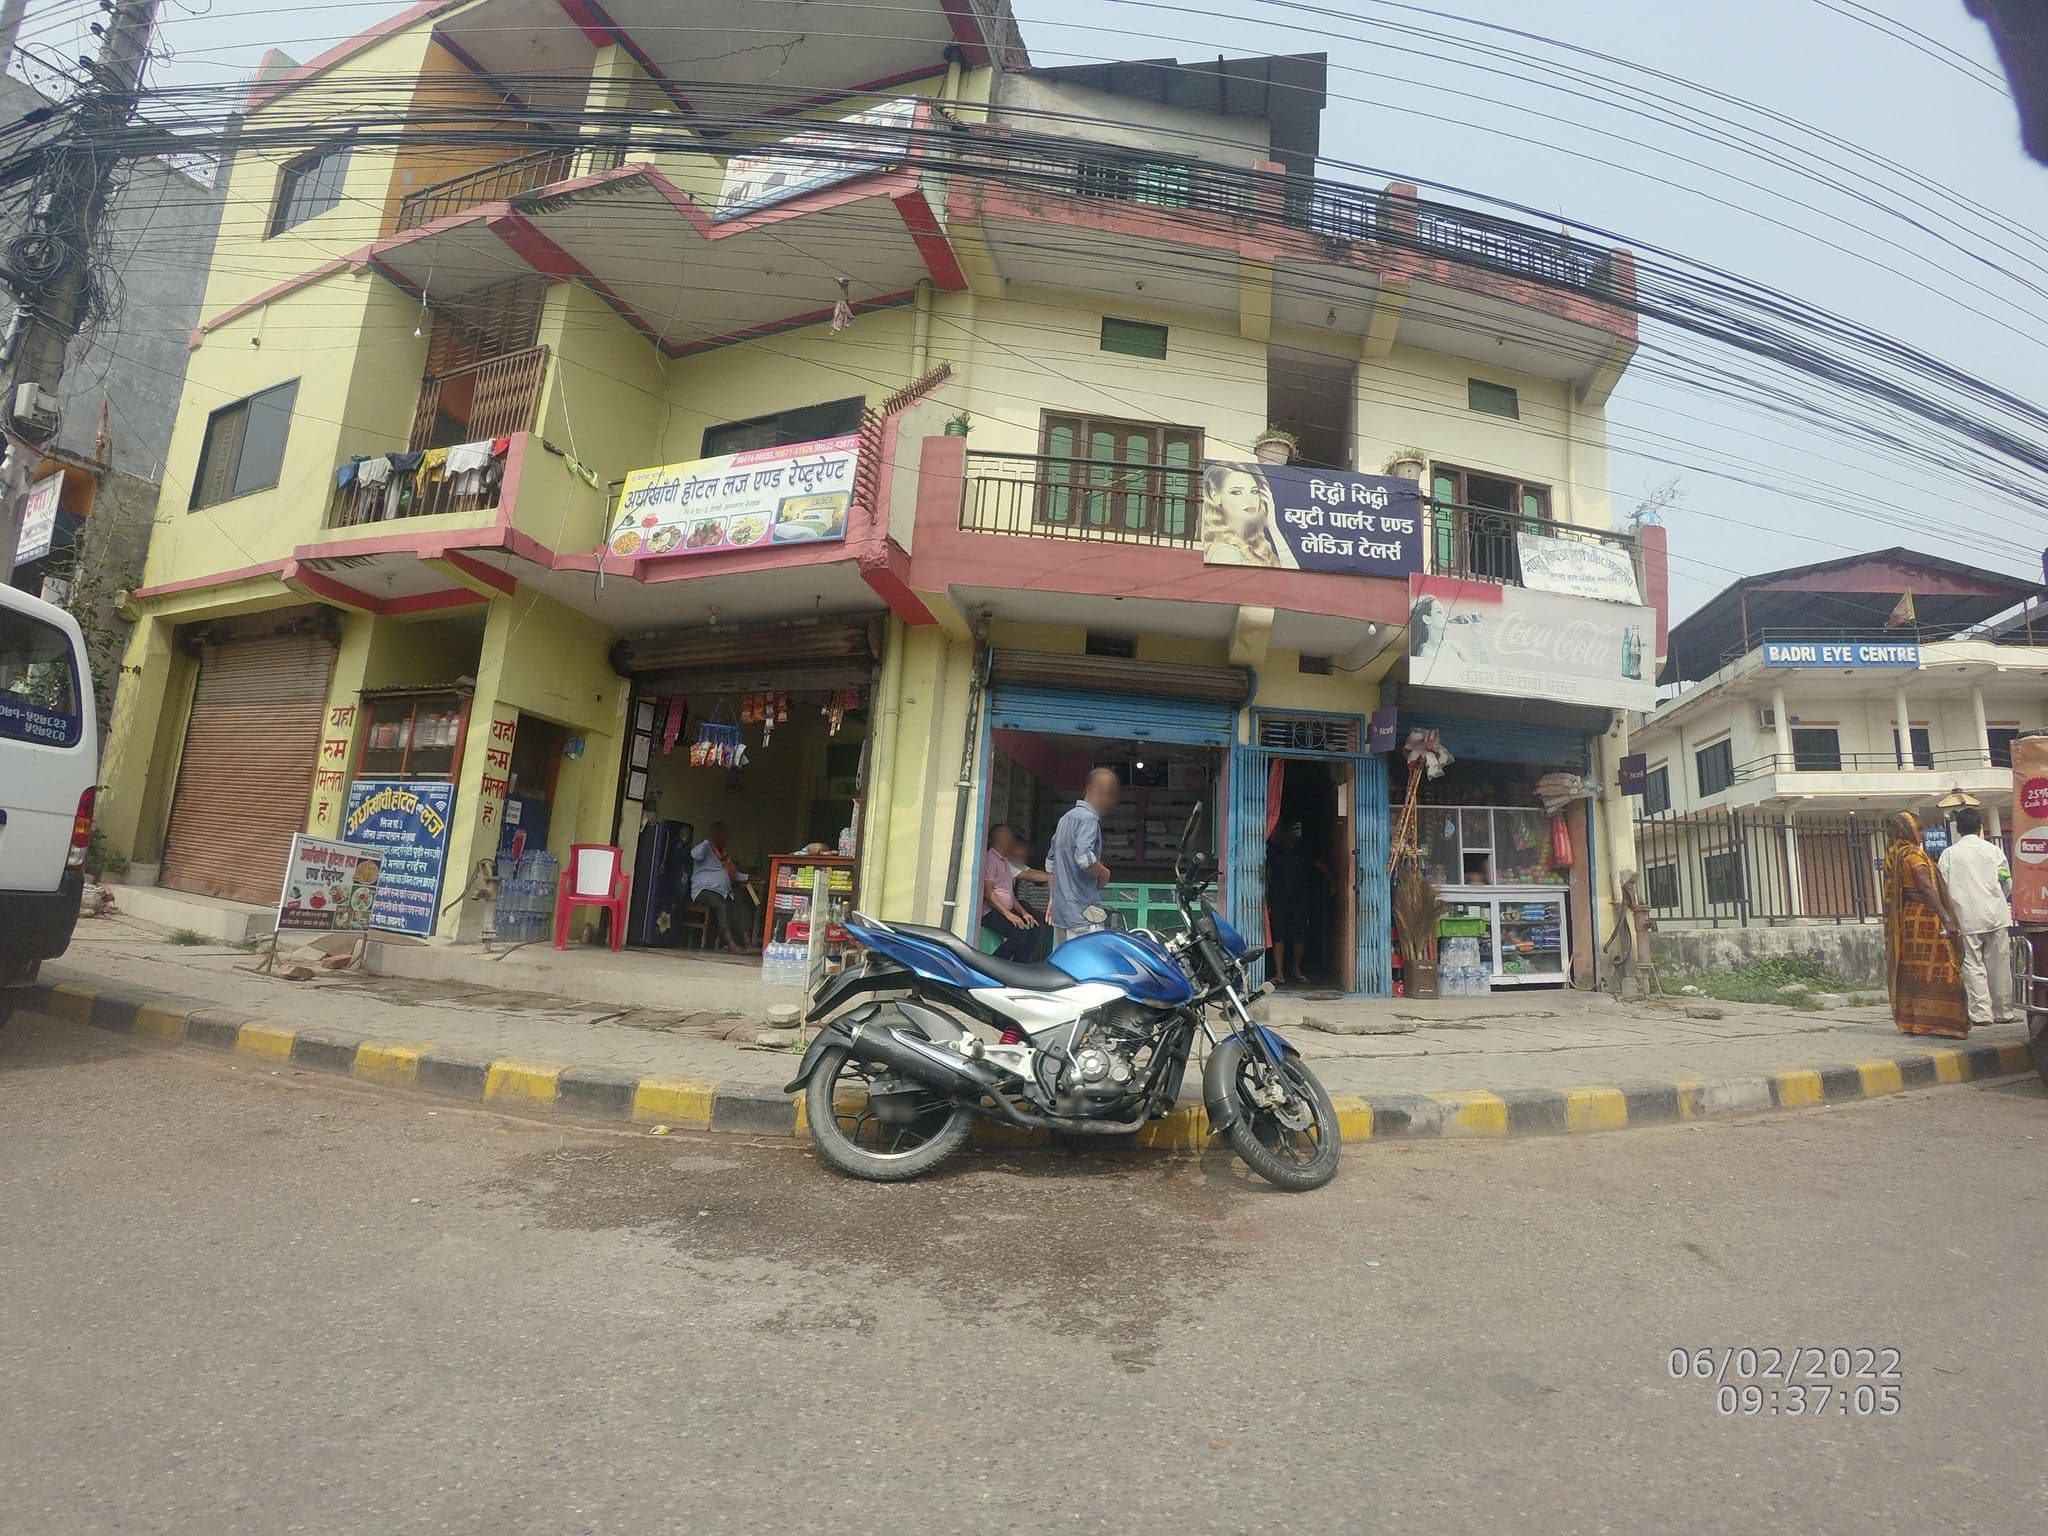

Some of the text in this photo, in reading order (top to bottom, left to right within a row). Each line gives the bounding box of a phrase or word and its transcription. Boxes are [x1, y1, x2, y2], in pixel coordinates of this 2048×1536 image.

[681, 475, 720, 506] होटल
[722, 473, 751, 496] लज
[753, 468, 785, 491] एण्ड
[1284, 506, 1414, 535] ब्युटी पार्लर एण्ड
[1300, 532, 1402, 562] लेडिज टेलर्स
[1768, 646, 1918, 662] BADRI EYE CENTRE
[316, 766, 346, 793] मिलता
[481, 772, 508, 801] मिलता
[420, 804, 445, 838] लज
